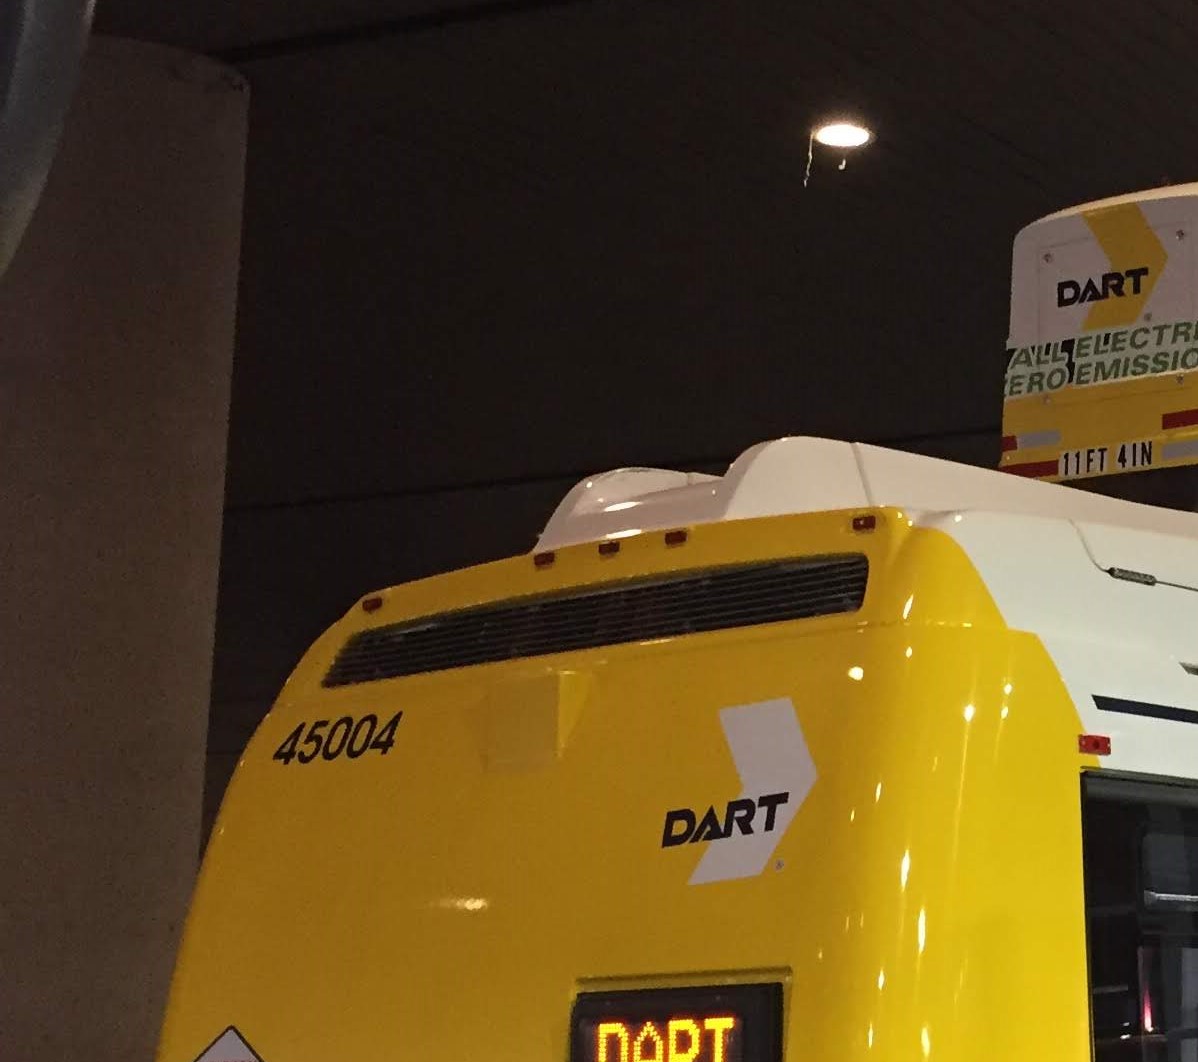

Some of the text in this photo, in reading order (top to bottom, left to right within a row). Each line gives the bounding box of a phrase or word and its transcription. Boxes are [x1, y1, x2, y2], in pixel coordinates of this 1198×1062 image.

[1057, 267, 1148, 307] DART
[1009, 342, 1066, 370] ALL
[1003, 367, 1067, 397] ERO
[273, 710, 403, 765] 45004
[661, 791, 789, 848] DART
